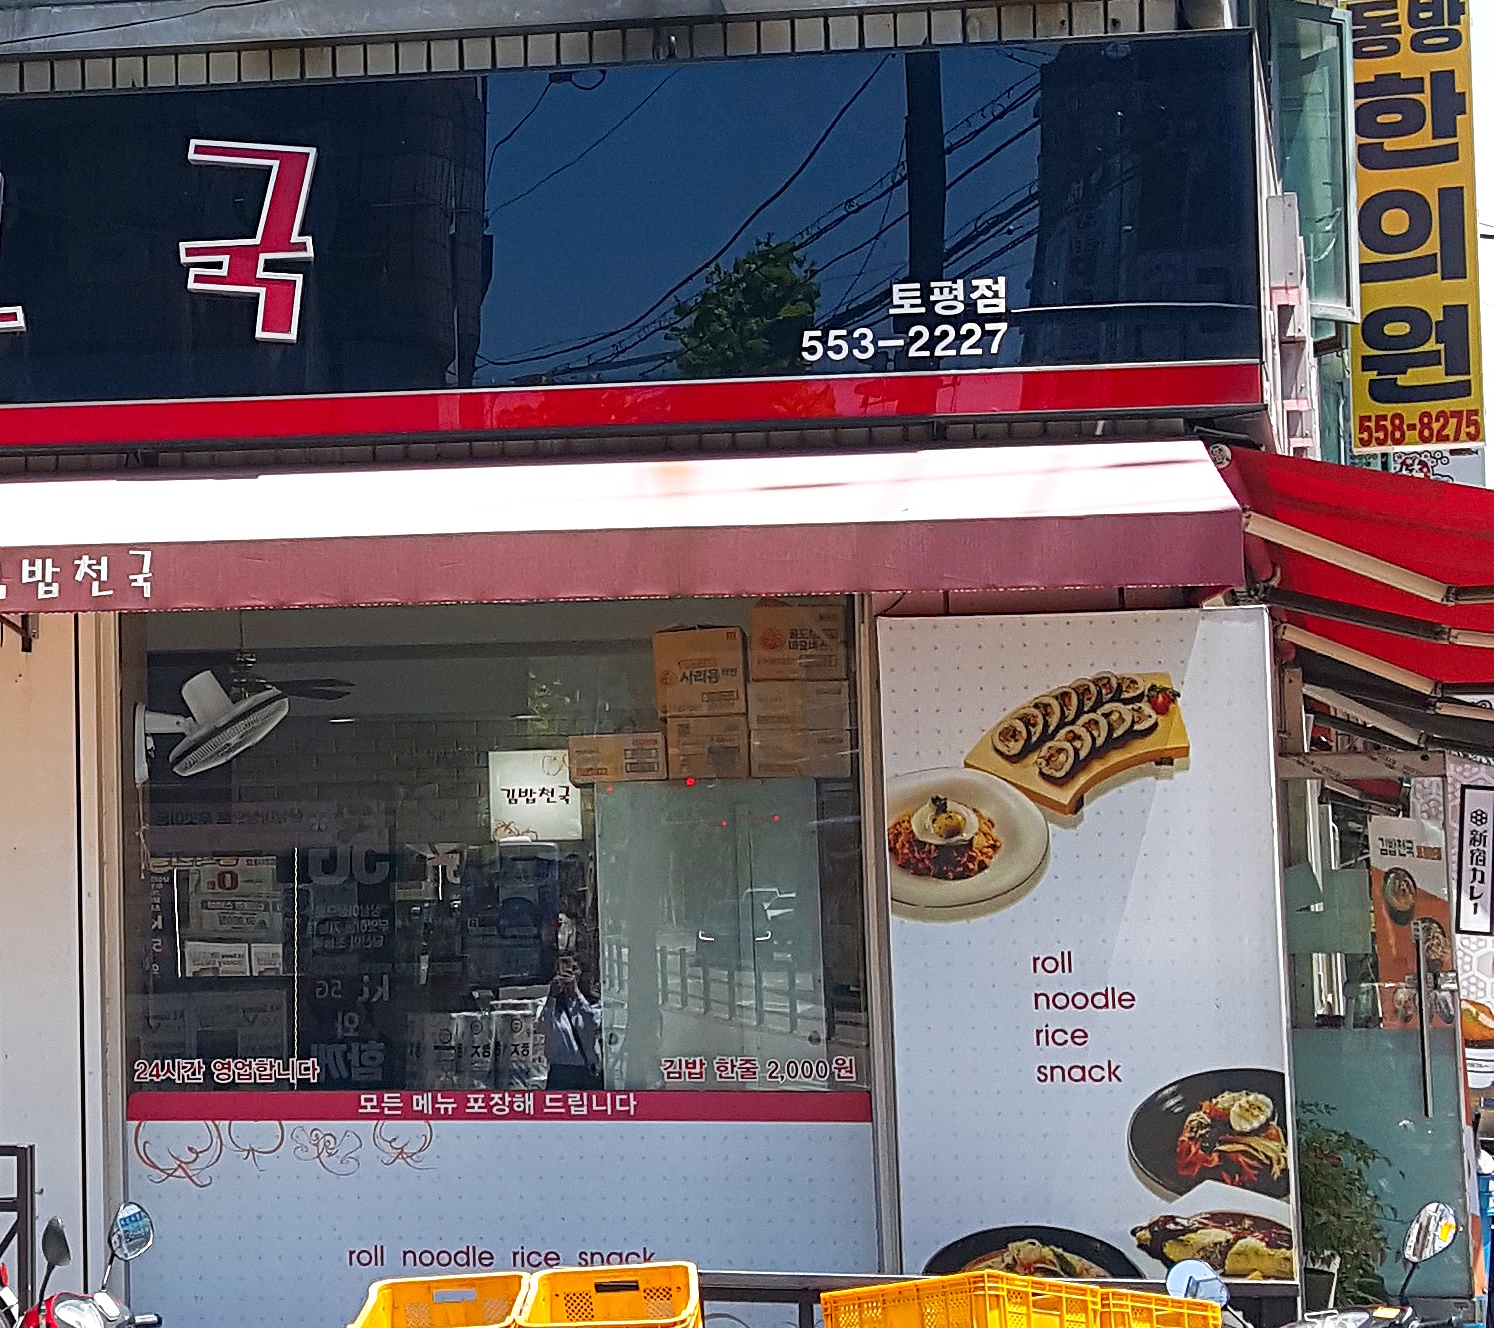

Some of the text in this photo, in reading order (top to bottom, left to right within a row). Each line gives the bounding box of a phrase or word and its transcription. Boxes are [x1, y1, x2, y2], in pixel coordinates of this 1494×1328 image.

[1353, 69, 1475, 405] 한의원
[888, 275, 1007, 316] 토평점
[801, 322, 1008, 363] 553-2227
[1357, 409, 1482, 449] 558-8275
[500, 785, 570, 804] 김밥천국
[1468, 829, 1488, 915] 新宿カレー
[1032, 951, 1073, 975] roll
[1033, 987, 1137, 1011] noodle
[1035, 1024, 1090, 1047] rice
[134, 1058, 320, 1083] 24시간 영업합니다
[662, 1056, 706, 1082] 김밥
[714, 1055, 760, 1082] 한줄
[1036, 1060, 1123, 1083] snack
[358, 1092, 637, 1115] 모든 메뉴 포장해 드립니다
[348, 1245, 385, 1267] roll
[402, 1245, 495, 1268] noodle
[512, 1245, 561, 1268] rice
